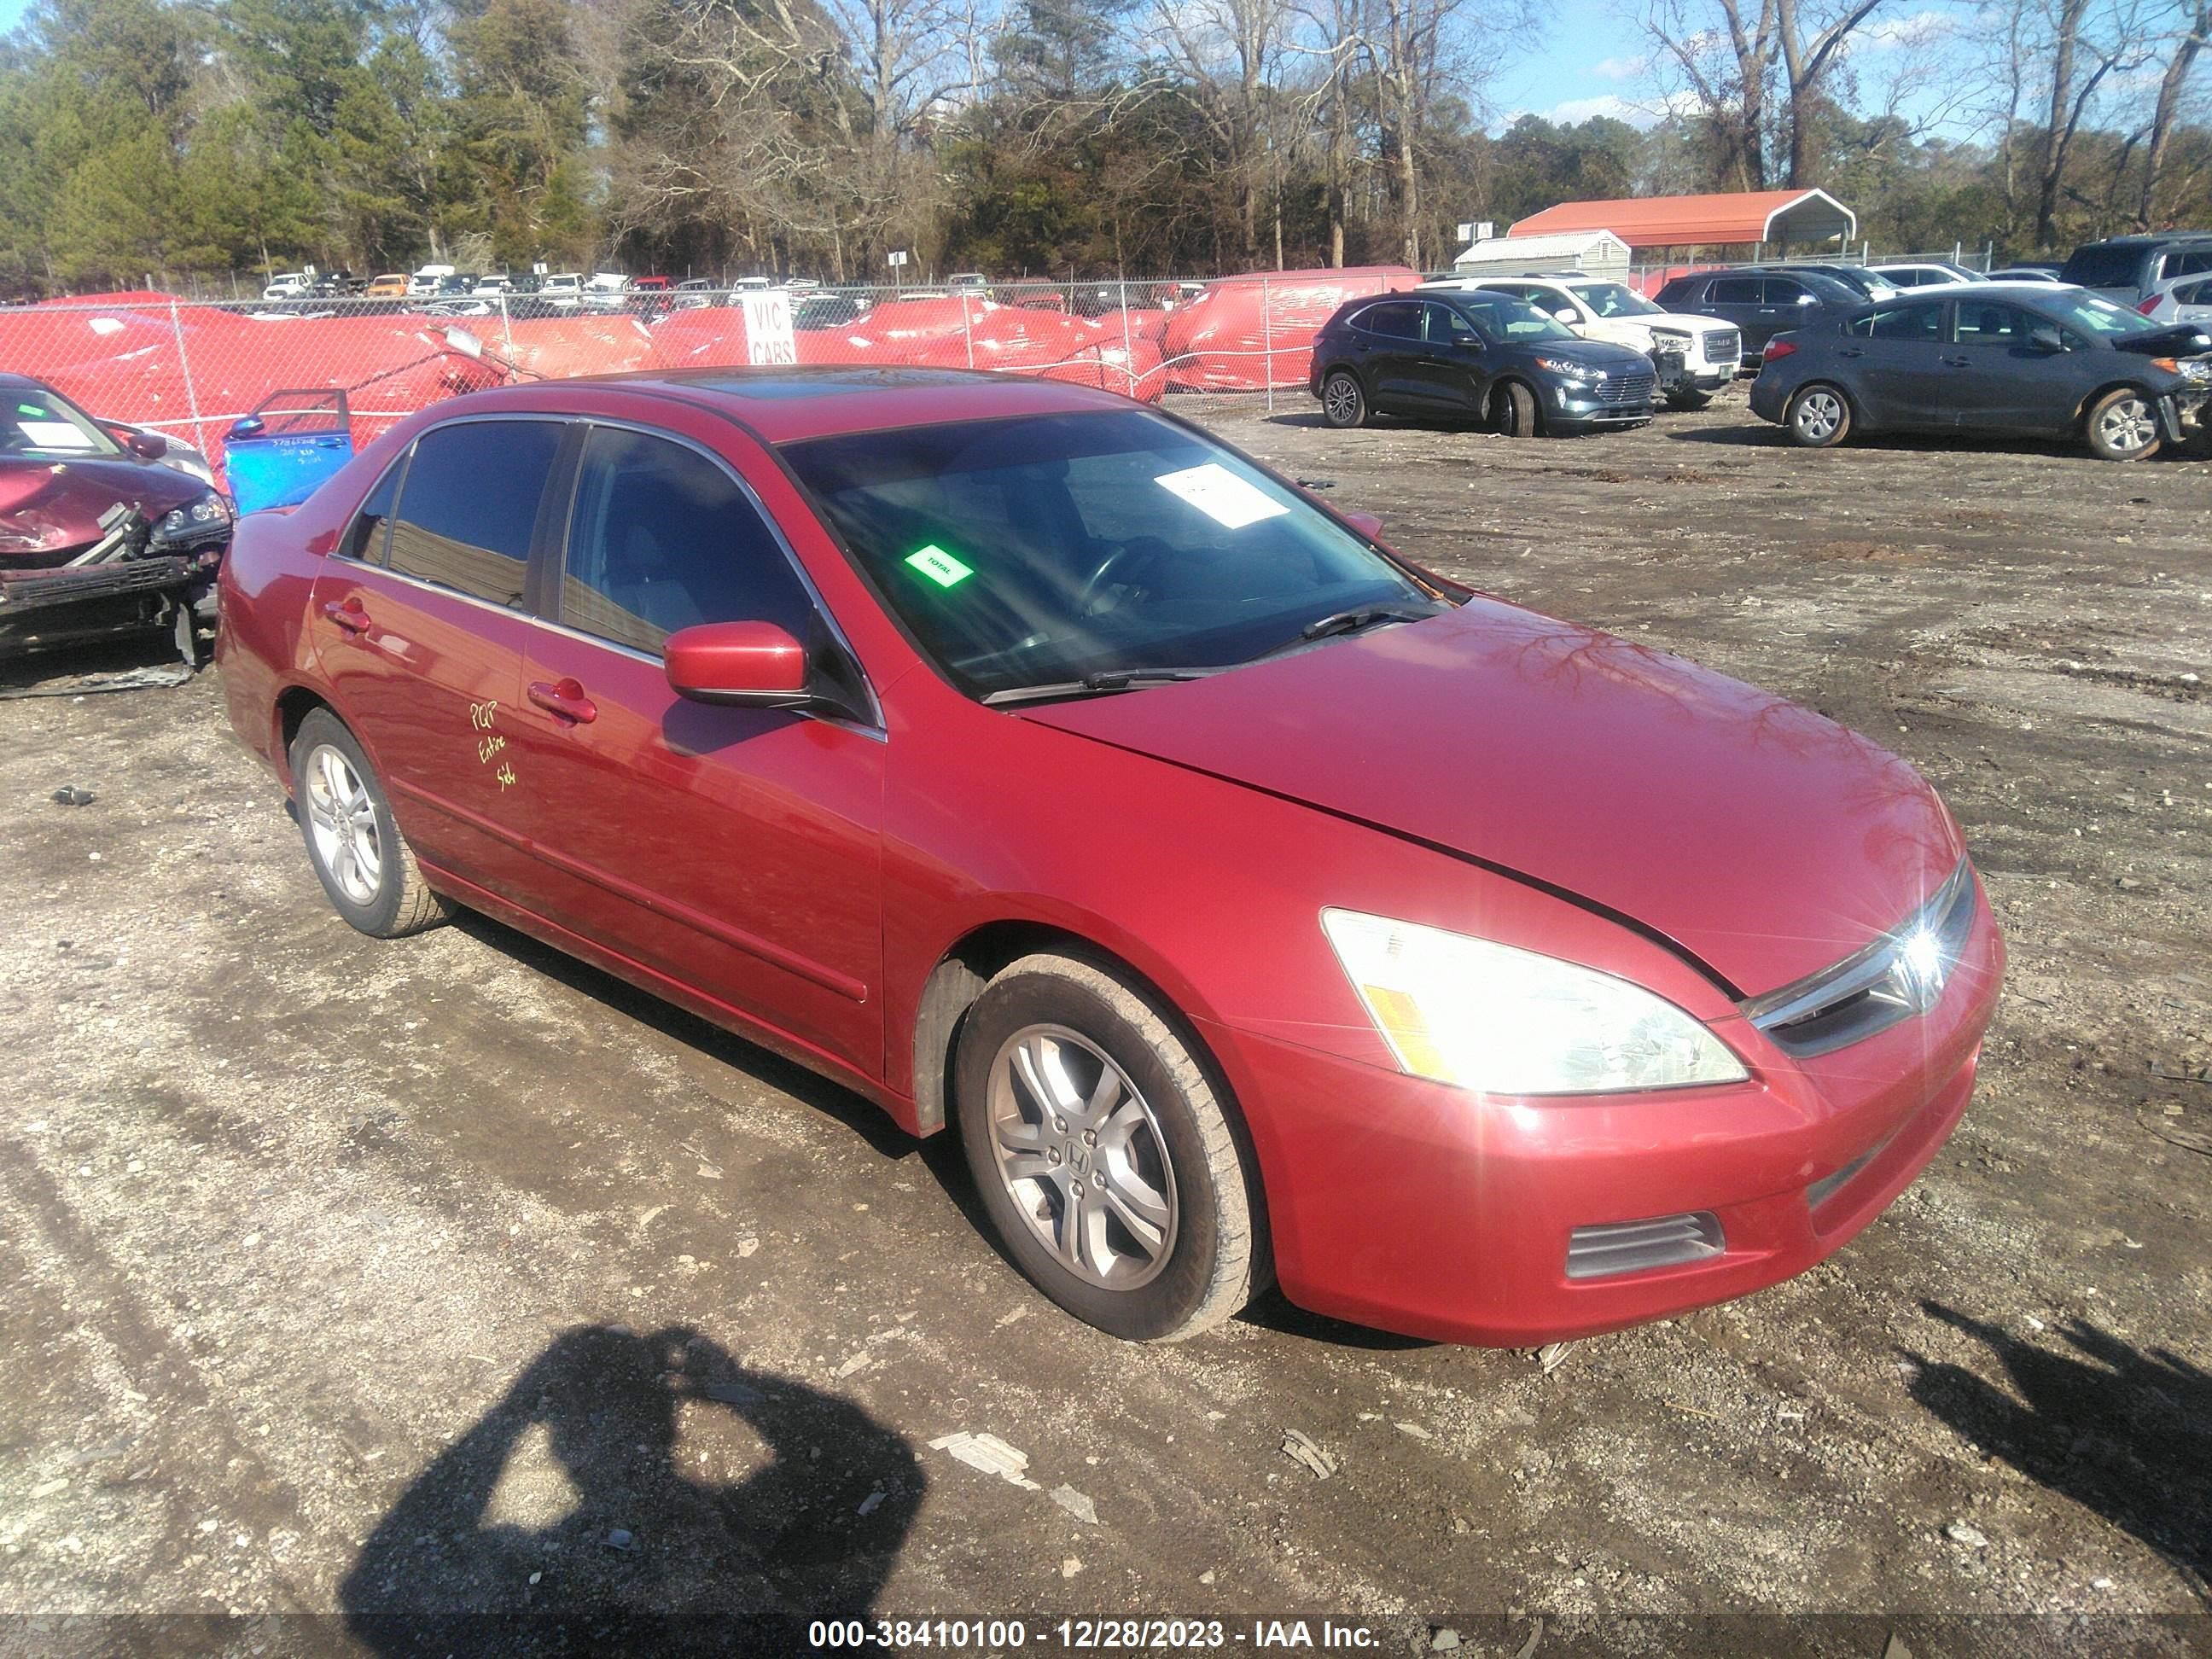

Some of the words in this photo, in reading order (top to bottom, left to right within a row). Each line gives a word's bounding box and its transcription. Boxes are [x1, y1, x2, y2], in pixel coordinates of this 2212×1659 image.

[754, 301, 781, 330] VIC
[754, 340, 793, 364] CARS
[928, 557, 952, 575] TOTAL
[478, 735, 506, 765] Entire
